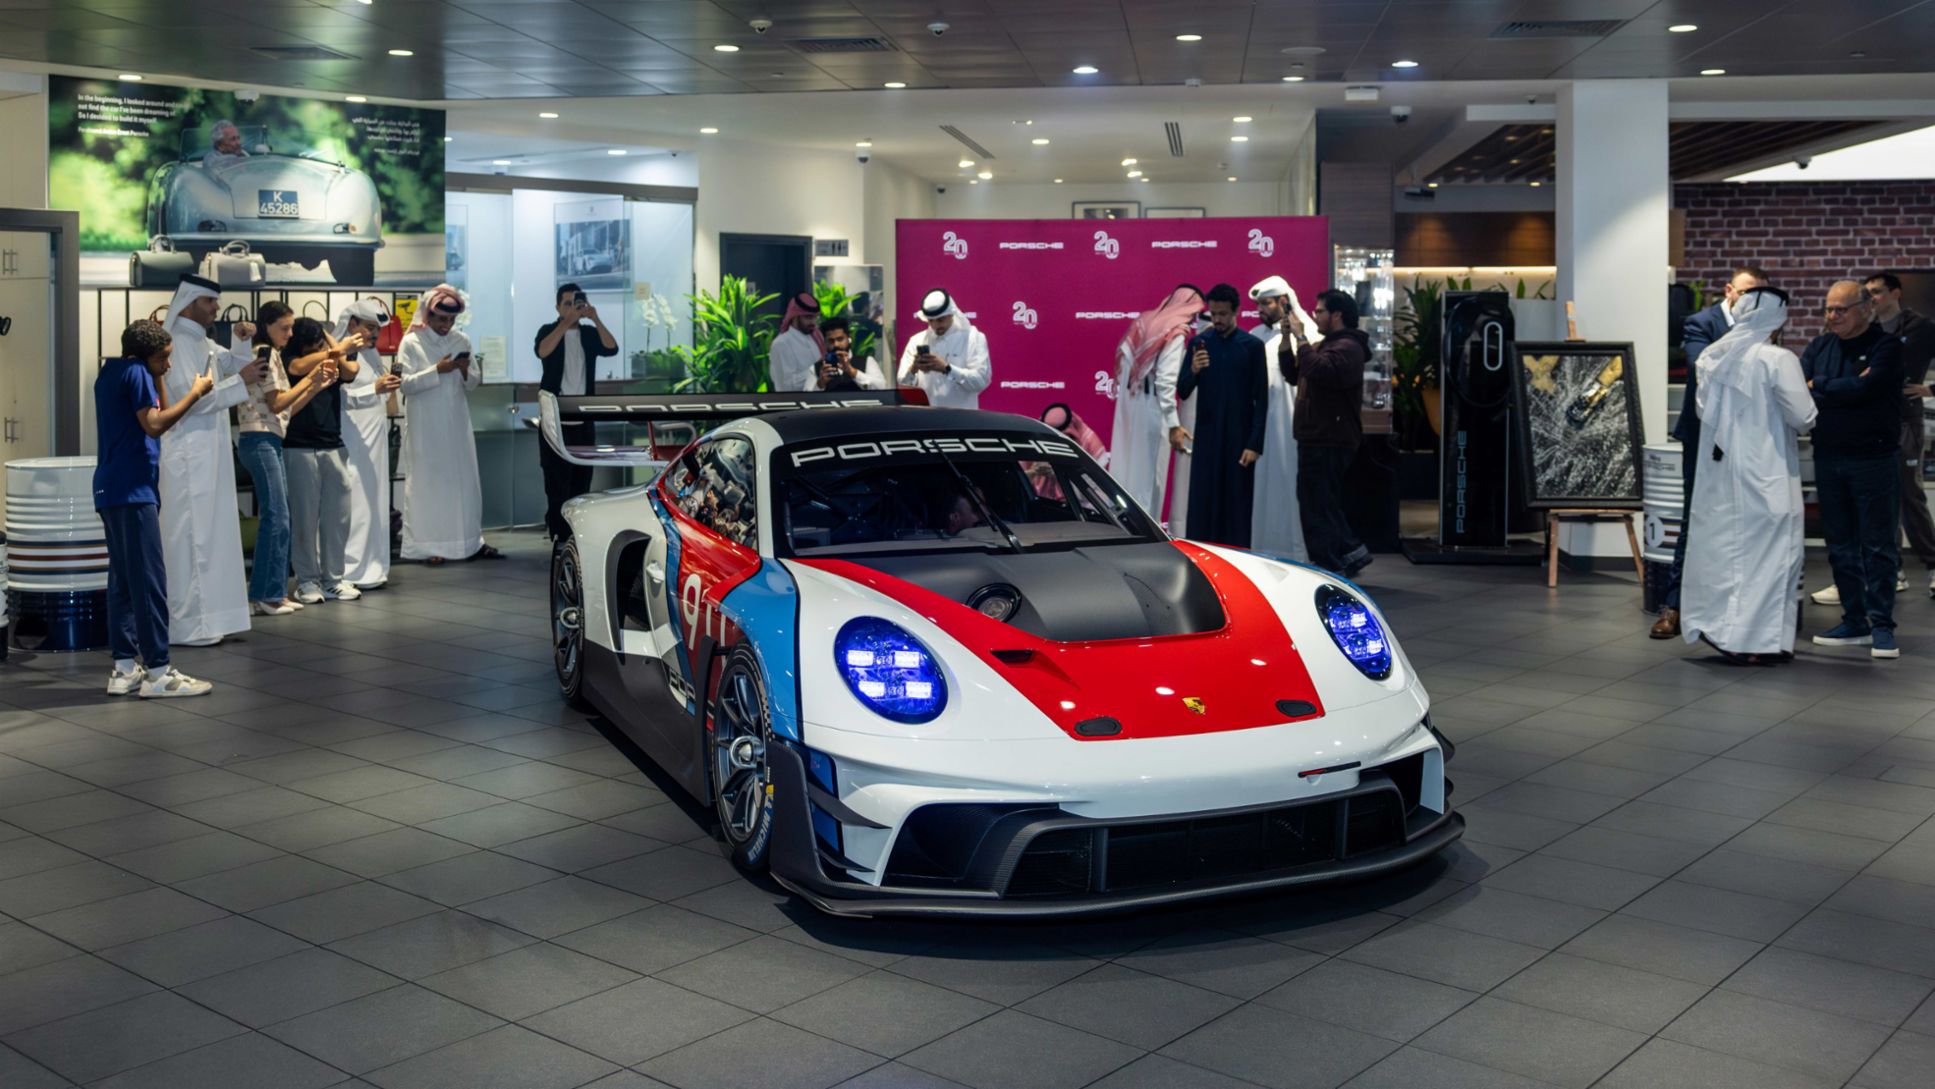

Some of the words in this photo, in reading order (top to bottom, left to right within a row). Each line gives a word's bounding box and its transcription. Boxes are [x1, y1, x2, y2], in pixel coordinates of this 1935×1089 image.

[260, 202, 299, 215] 45286
[273, 191, 283, 202] K
[943, 231, 968, 259] 20
[1094, 230, 1120, 259] 20
[1248, 228, 1274, 257] 20
[1012, 301, 1038, 329] 20
[1075, 311, 1140, 319] PORSCHE
[1000, 381, 1065, 389] PORSCHE
[791, 438, 1079, 467] PORSCHE
[1456, 431, 1467, 533] PORSCHE
